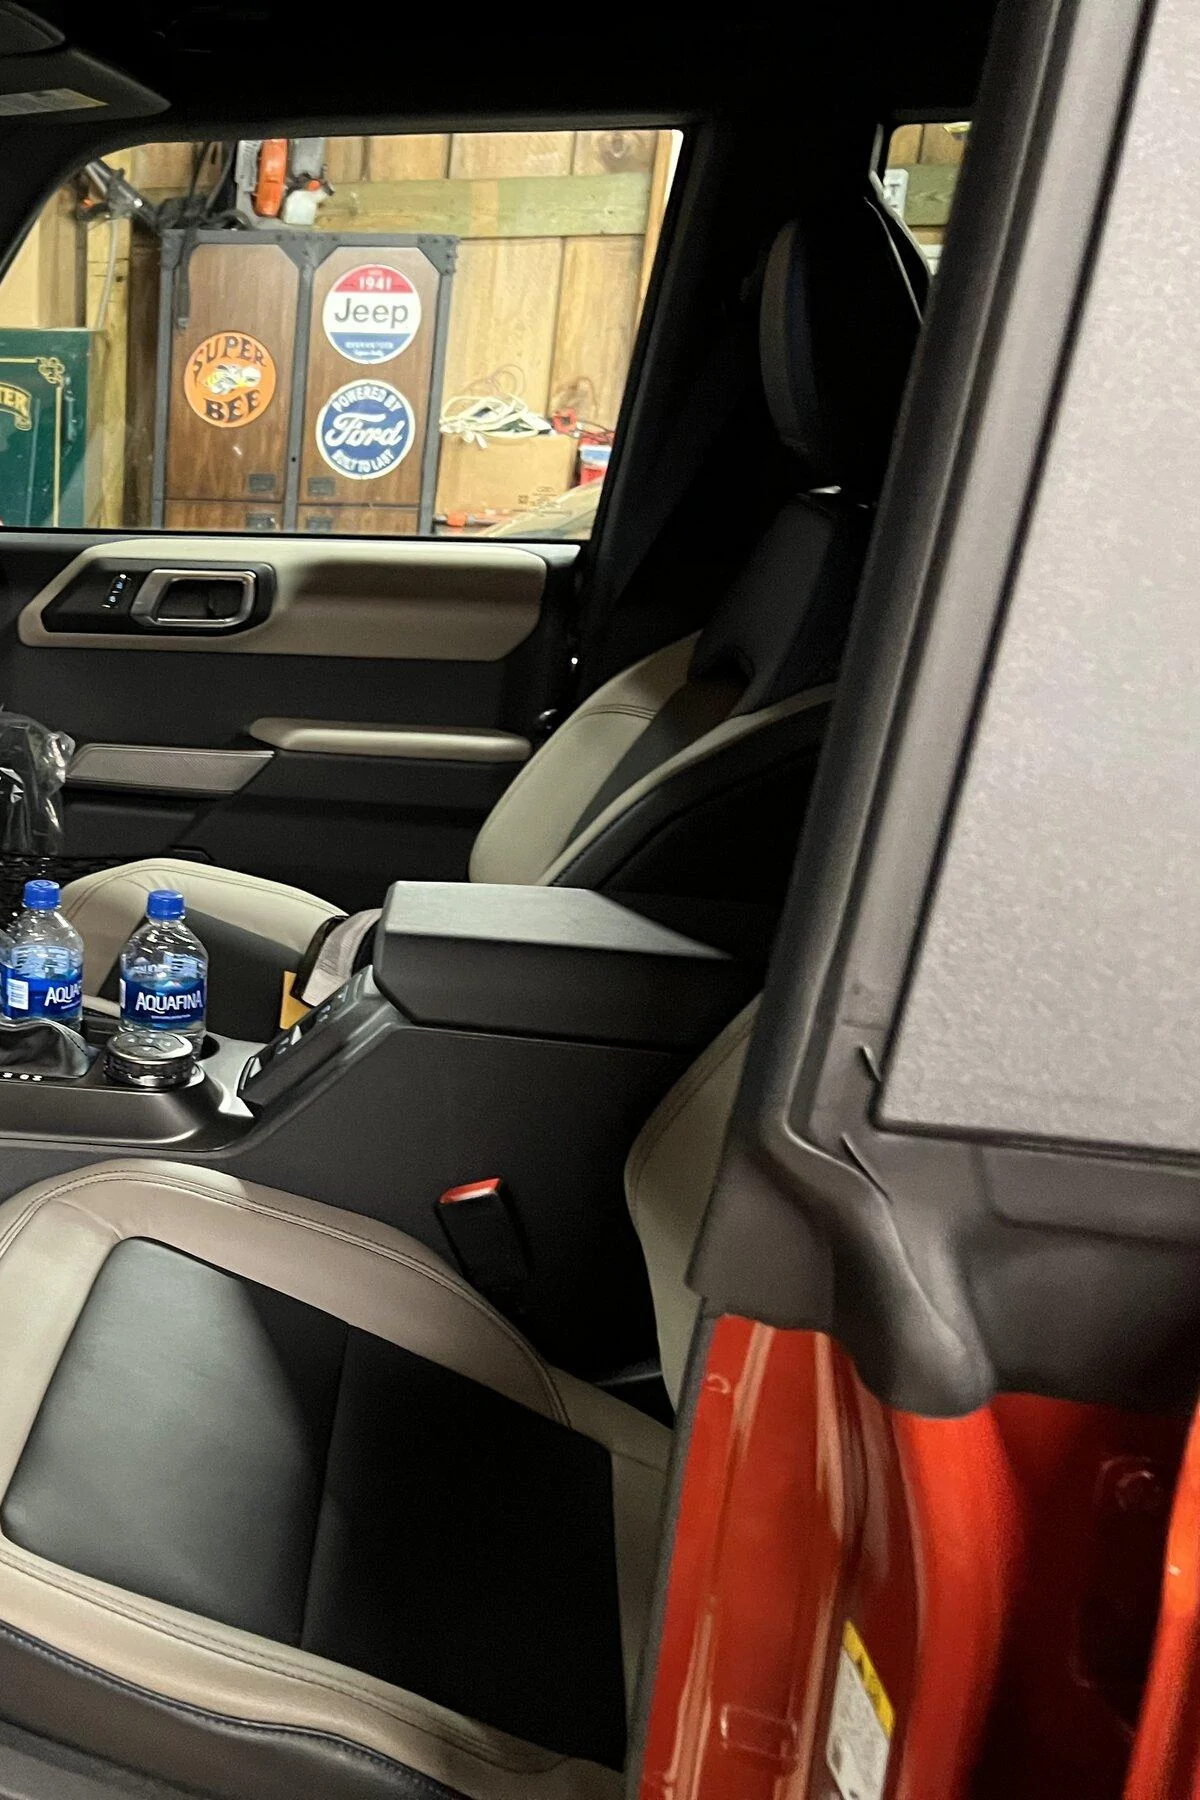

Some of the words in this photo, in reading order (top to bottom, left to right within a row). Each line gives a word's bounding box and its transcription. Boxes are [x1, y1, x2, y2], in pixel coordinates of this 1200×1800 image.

[359, 275, 392, 291] 1941
[334, 298, 409, 329] Jeep
[192, 336, 267, 388] SUPER
[203, 389, 261, 422] BEE
[332, 386, 388, 413] POWERED
[384, 394, 403, 412] BY
[324, 413, 405, 447] Ford
[135, 990, 203, 1014] AQUAFINA
